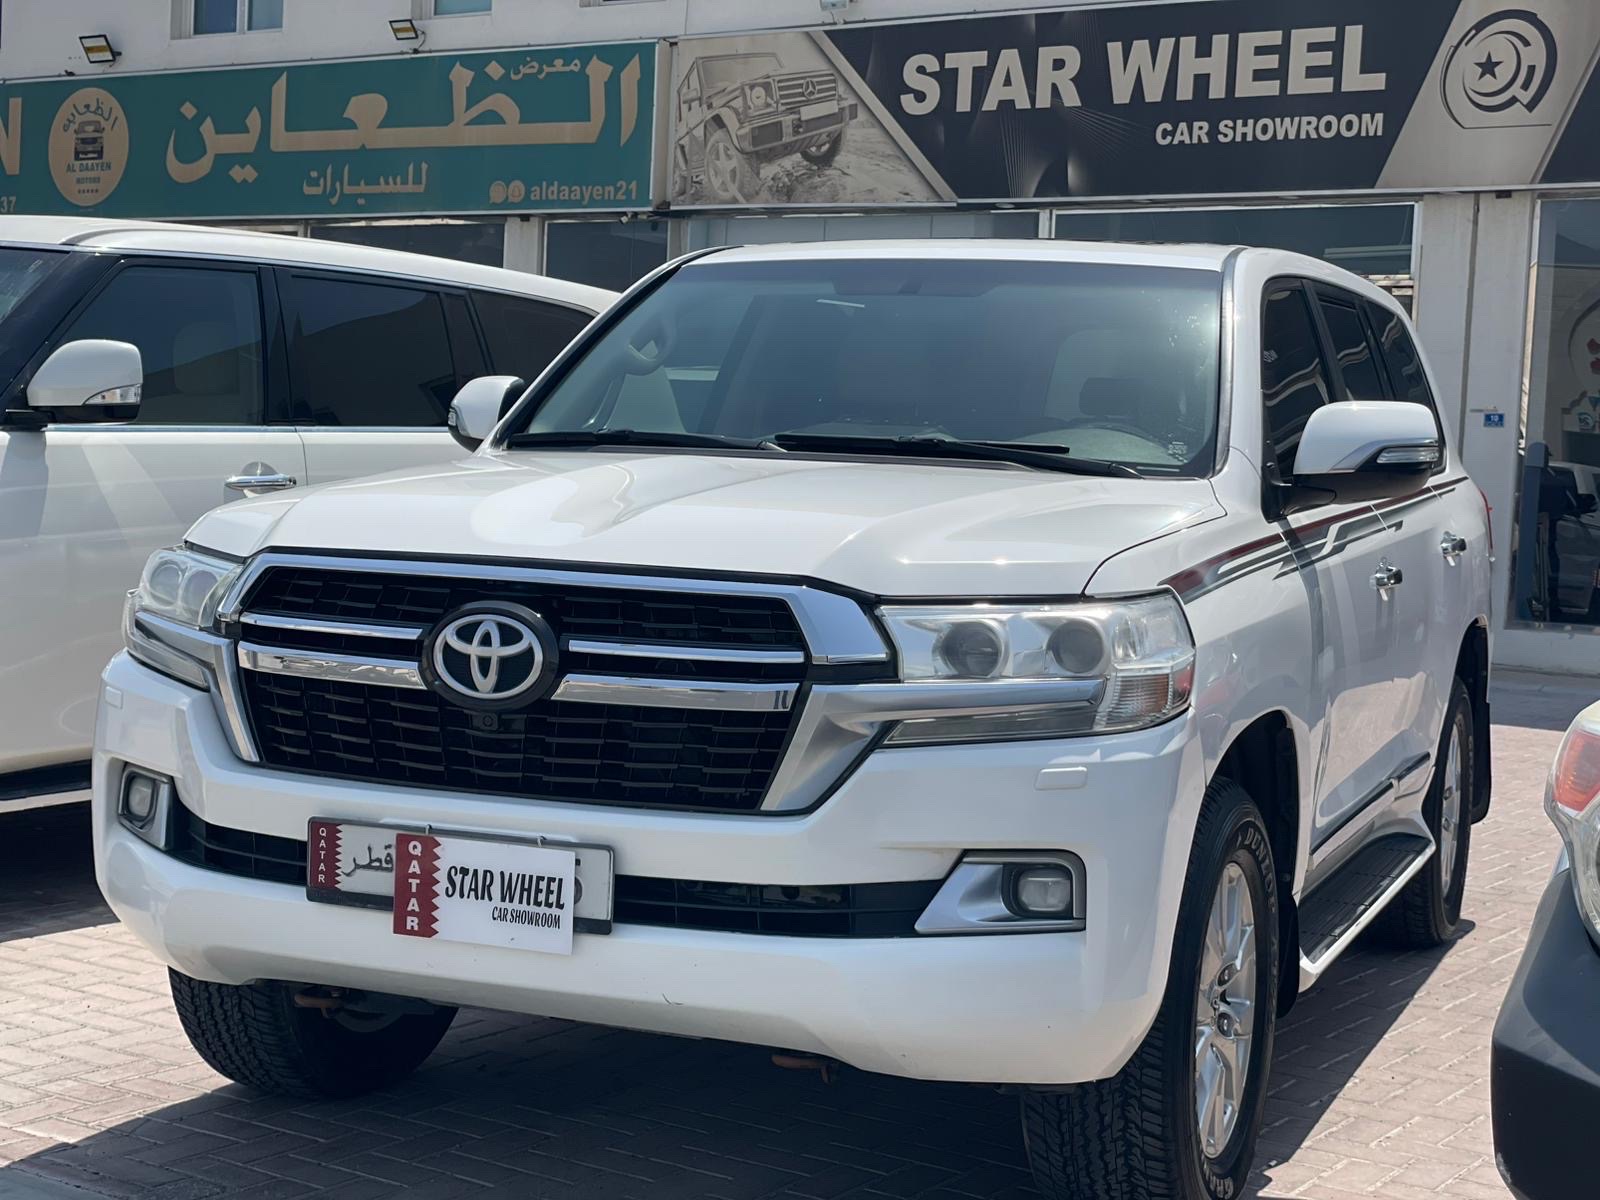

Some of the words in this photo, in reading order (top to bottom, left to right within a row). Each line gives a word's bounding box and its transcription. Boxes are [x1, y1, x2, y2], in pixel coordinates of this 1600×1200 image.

[510, 56, 582, 81] معرض
[900, 45, 1082, 116] STAR
[1106, 24, 1387, 105] WHEEL
[165, 52, 642, 184] الظعاين
[1155, 121, 1210, 146] CAR
[1217, 112, 1385, 143] SHOWROOM
[66, 162, 77, 173] AL
[79, 161, 112, 172] DAAYEN
[302, 160, 429, 206] للسيارات
[530, 180, 638, 205] aldaayen21
[318, 827, 327, 884] QATAR
[340, 843, 394, 877] قطر
[406, 840, 422, 932] QATAR
[444, 865, 494, 902] STAR
[499, 871, 565, 910] WHEEL
[491, 906, 508, 922] CAR
[509, 908, 561, 930] SHOWROOM
